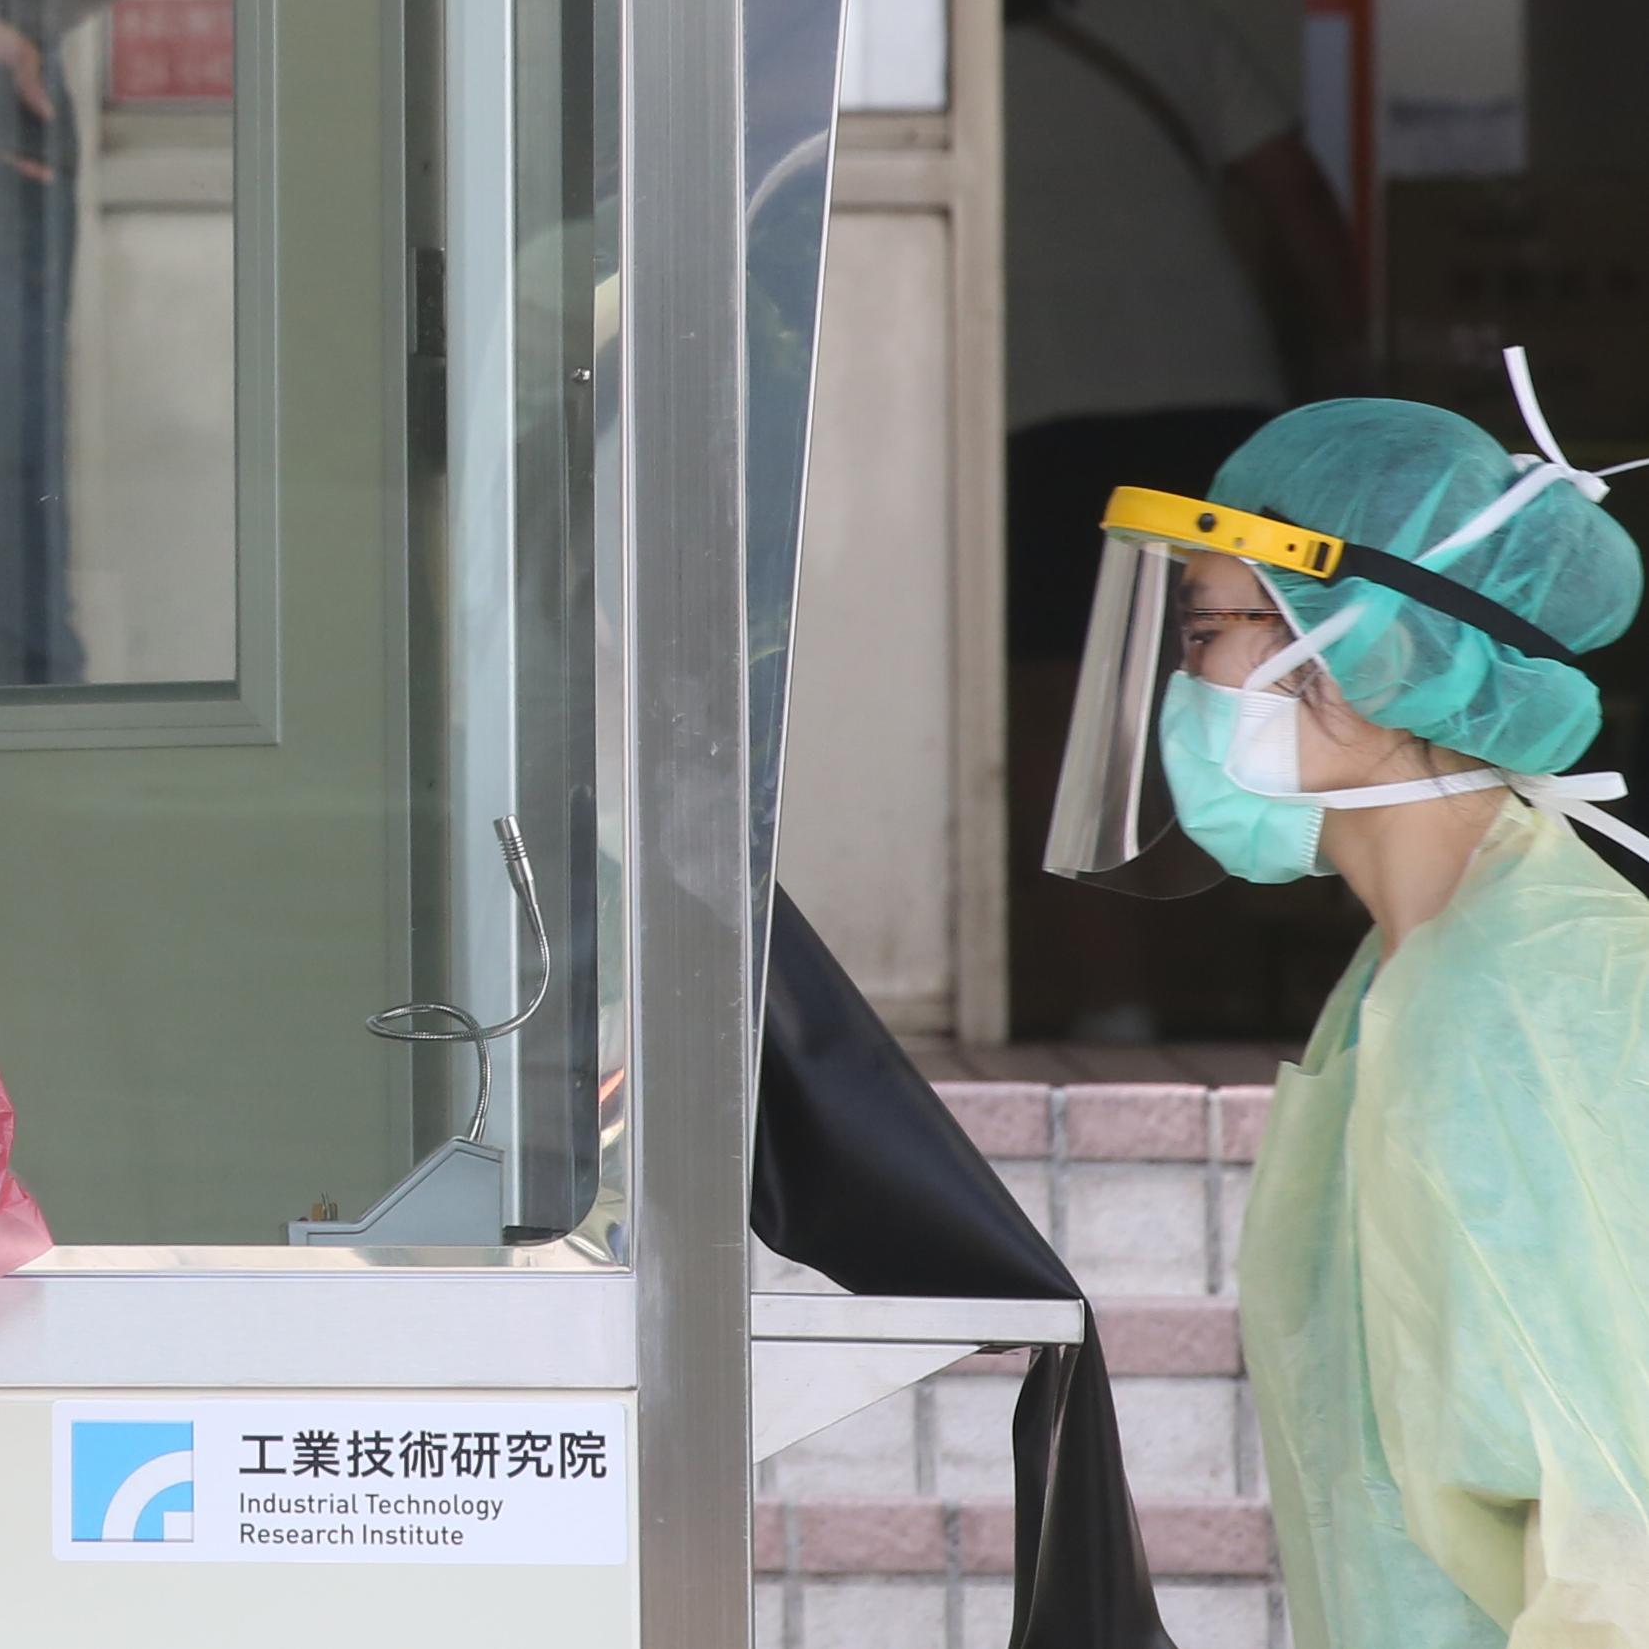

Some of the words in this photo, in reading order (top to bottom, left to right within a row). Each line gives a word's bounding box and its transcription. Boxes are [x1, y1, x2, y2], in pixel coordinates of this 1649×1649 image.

[239, 1430, 607, 1479] 工業技術研究院
[239, 1492, 358, 1515] Industrial
[365, 1493, 504, 1522] Technology
[239, 1523, 355, 1547] Research
[362, 1524, 465, 1546] Institute
